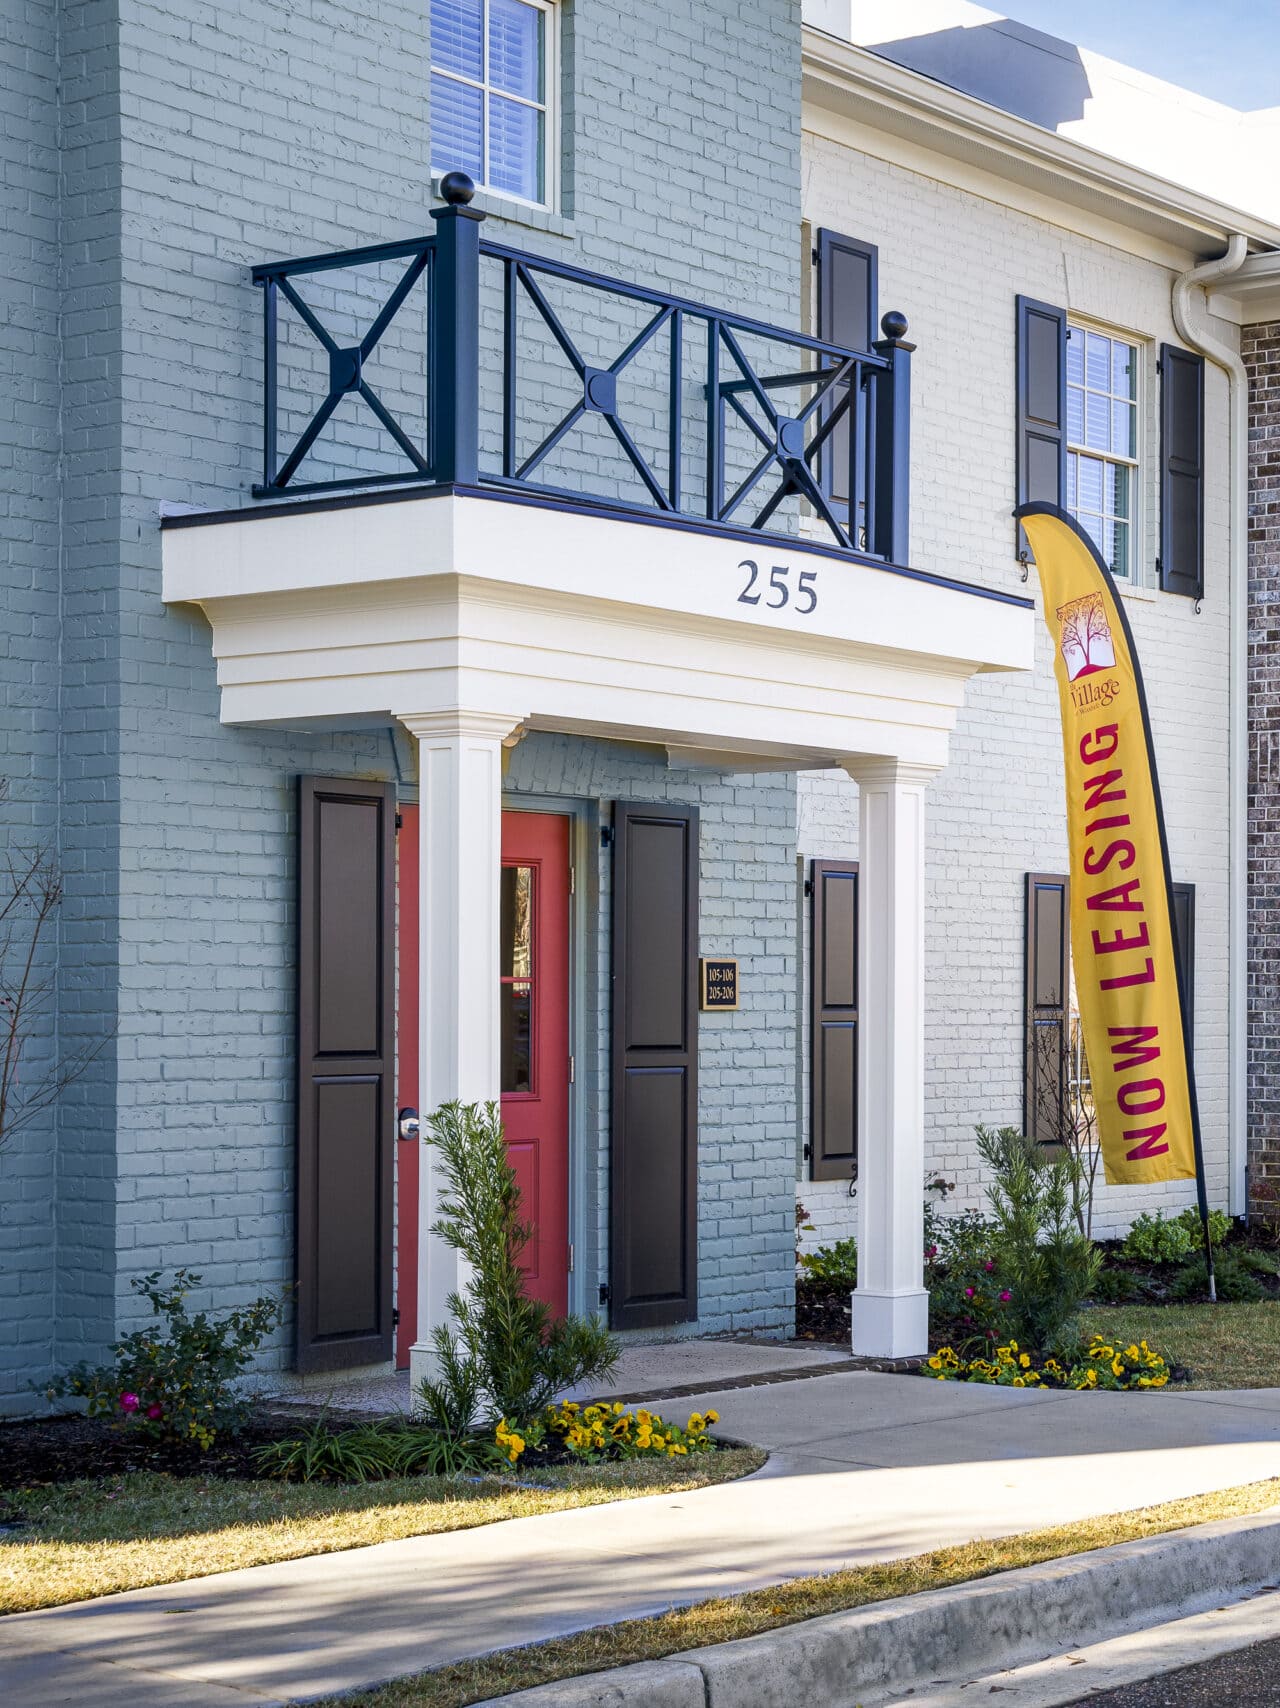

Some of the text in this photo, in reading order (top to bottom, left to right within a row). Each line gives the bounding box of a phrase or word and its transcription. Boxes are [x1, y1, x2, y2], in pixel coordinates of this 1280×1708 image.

[737, 559, 818, 614] 255
[1079, 723, 1170, 1162] NOW LEASING
[709, 968, 734, 982] 105-106
[708, 986, 734, 1000] 205-206
